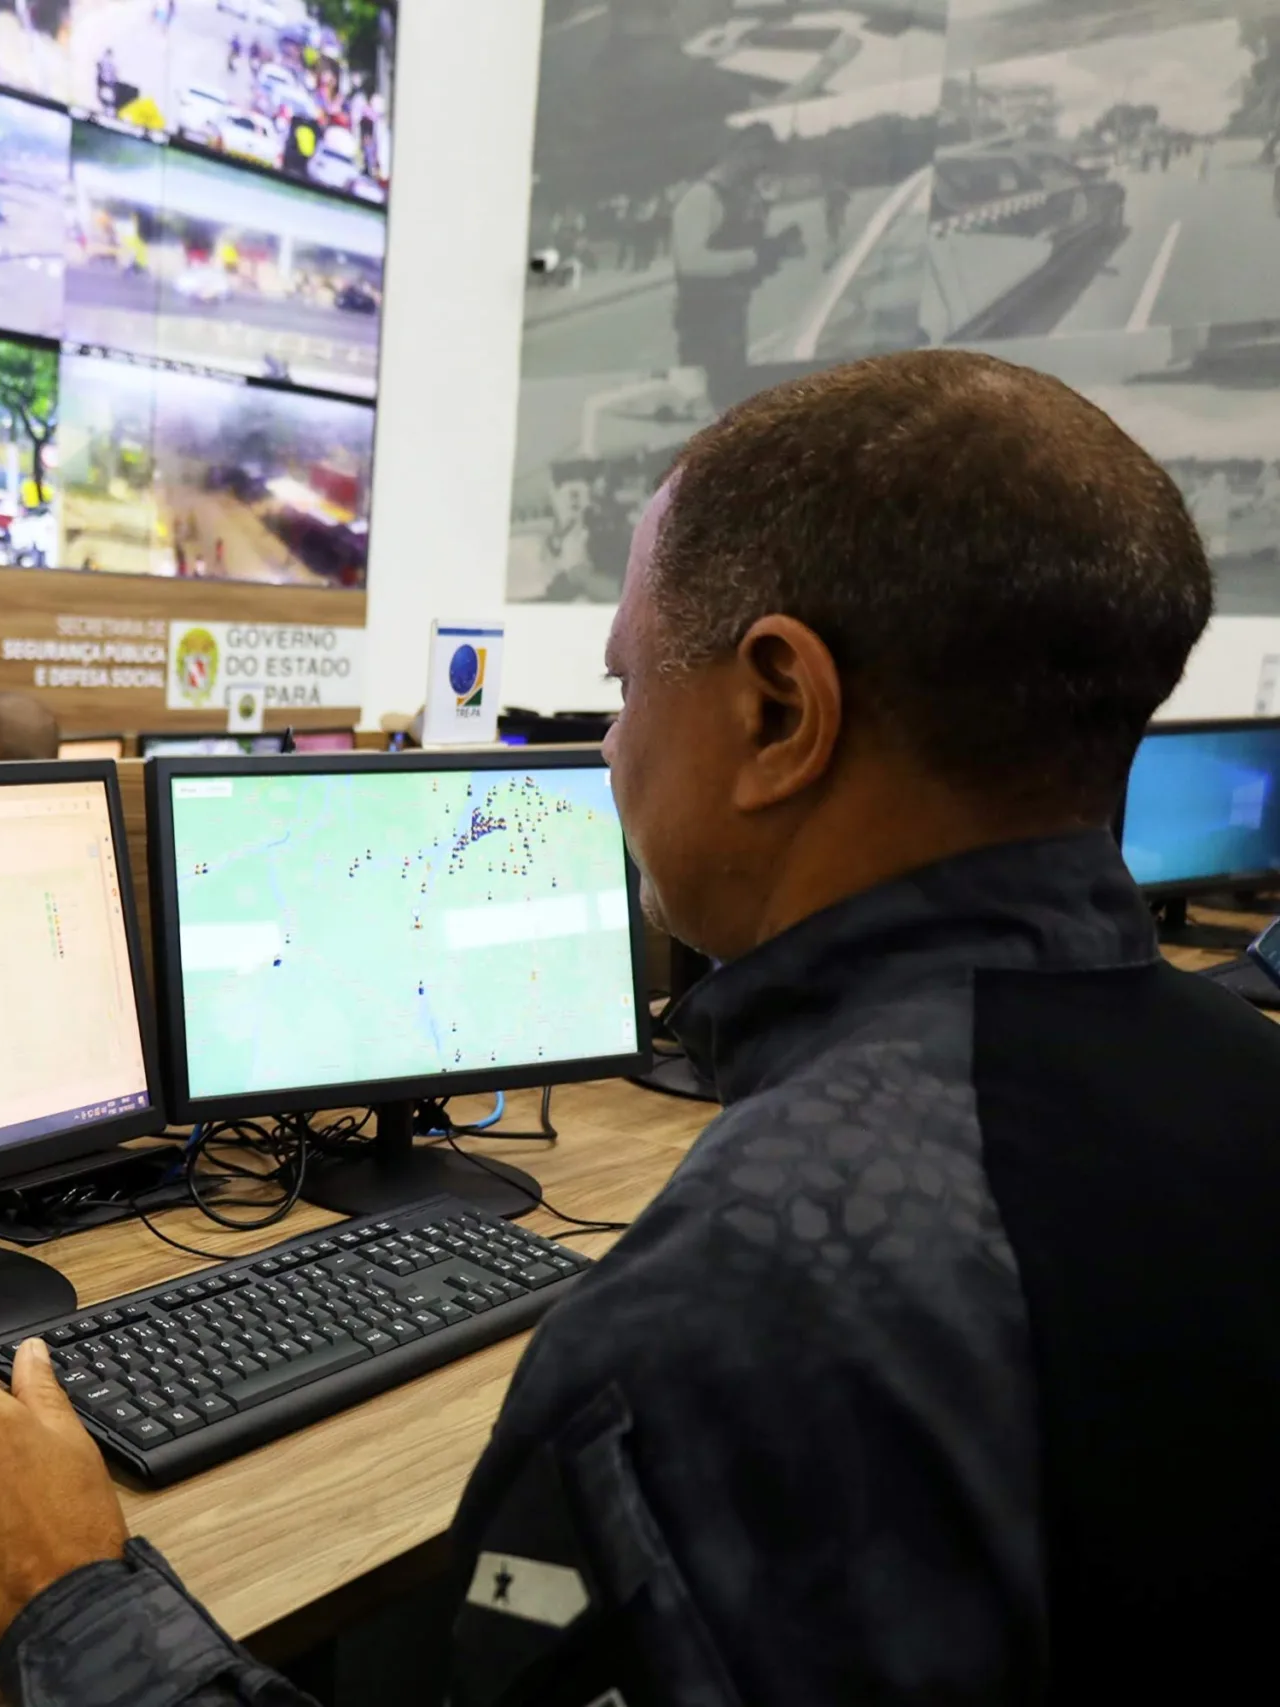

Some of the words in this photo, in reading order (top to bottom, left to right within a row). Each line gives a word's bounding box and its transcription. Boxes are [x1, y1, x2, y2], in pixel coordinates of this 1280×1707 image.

[226, 628, 337, 651] GOVERNO
[34, 664, 46, 687] E
[49, 667, 108, 687] DEFESA
[111, 668, 164, 687] SOCIAL
[225, 656, 258, 677] DO
[266, 657, 351, 677] ESTADO
